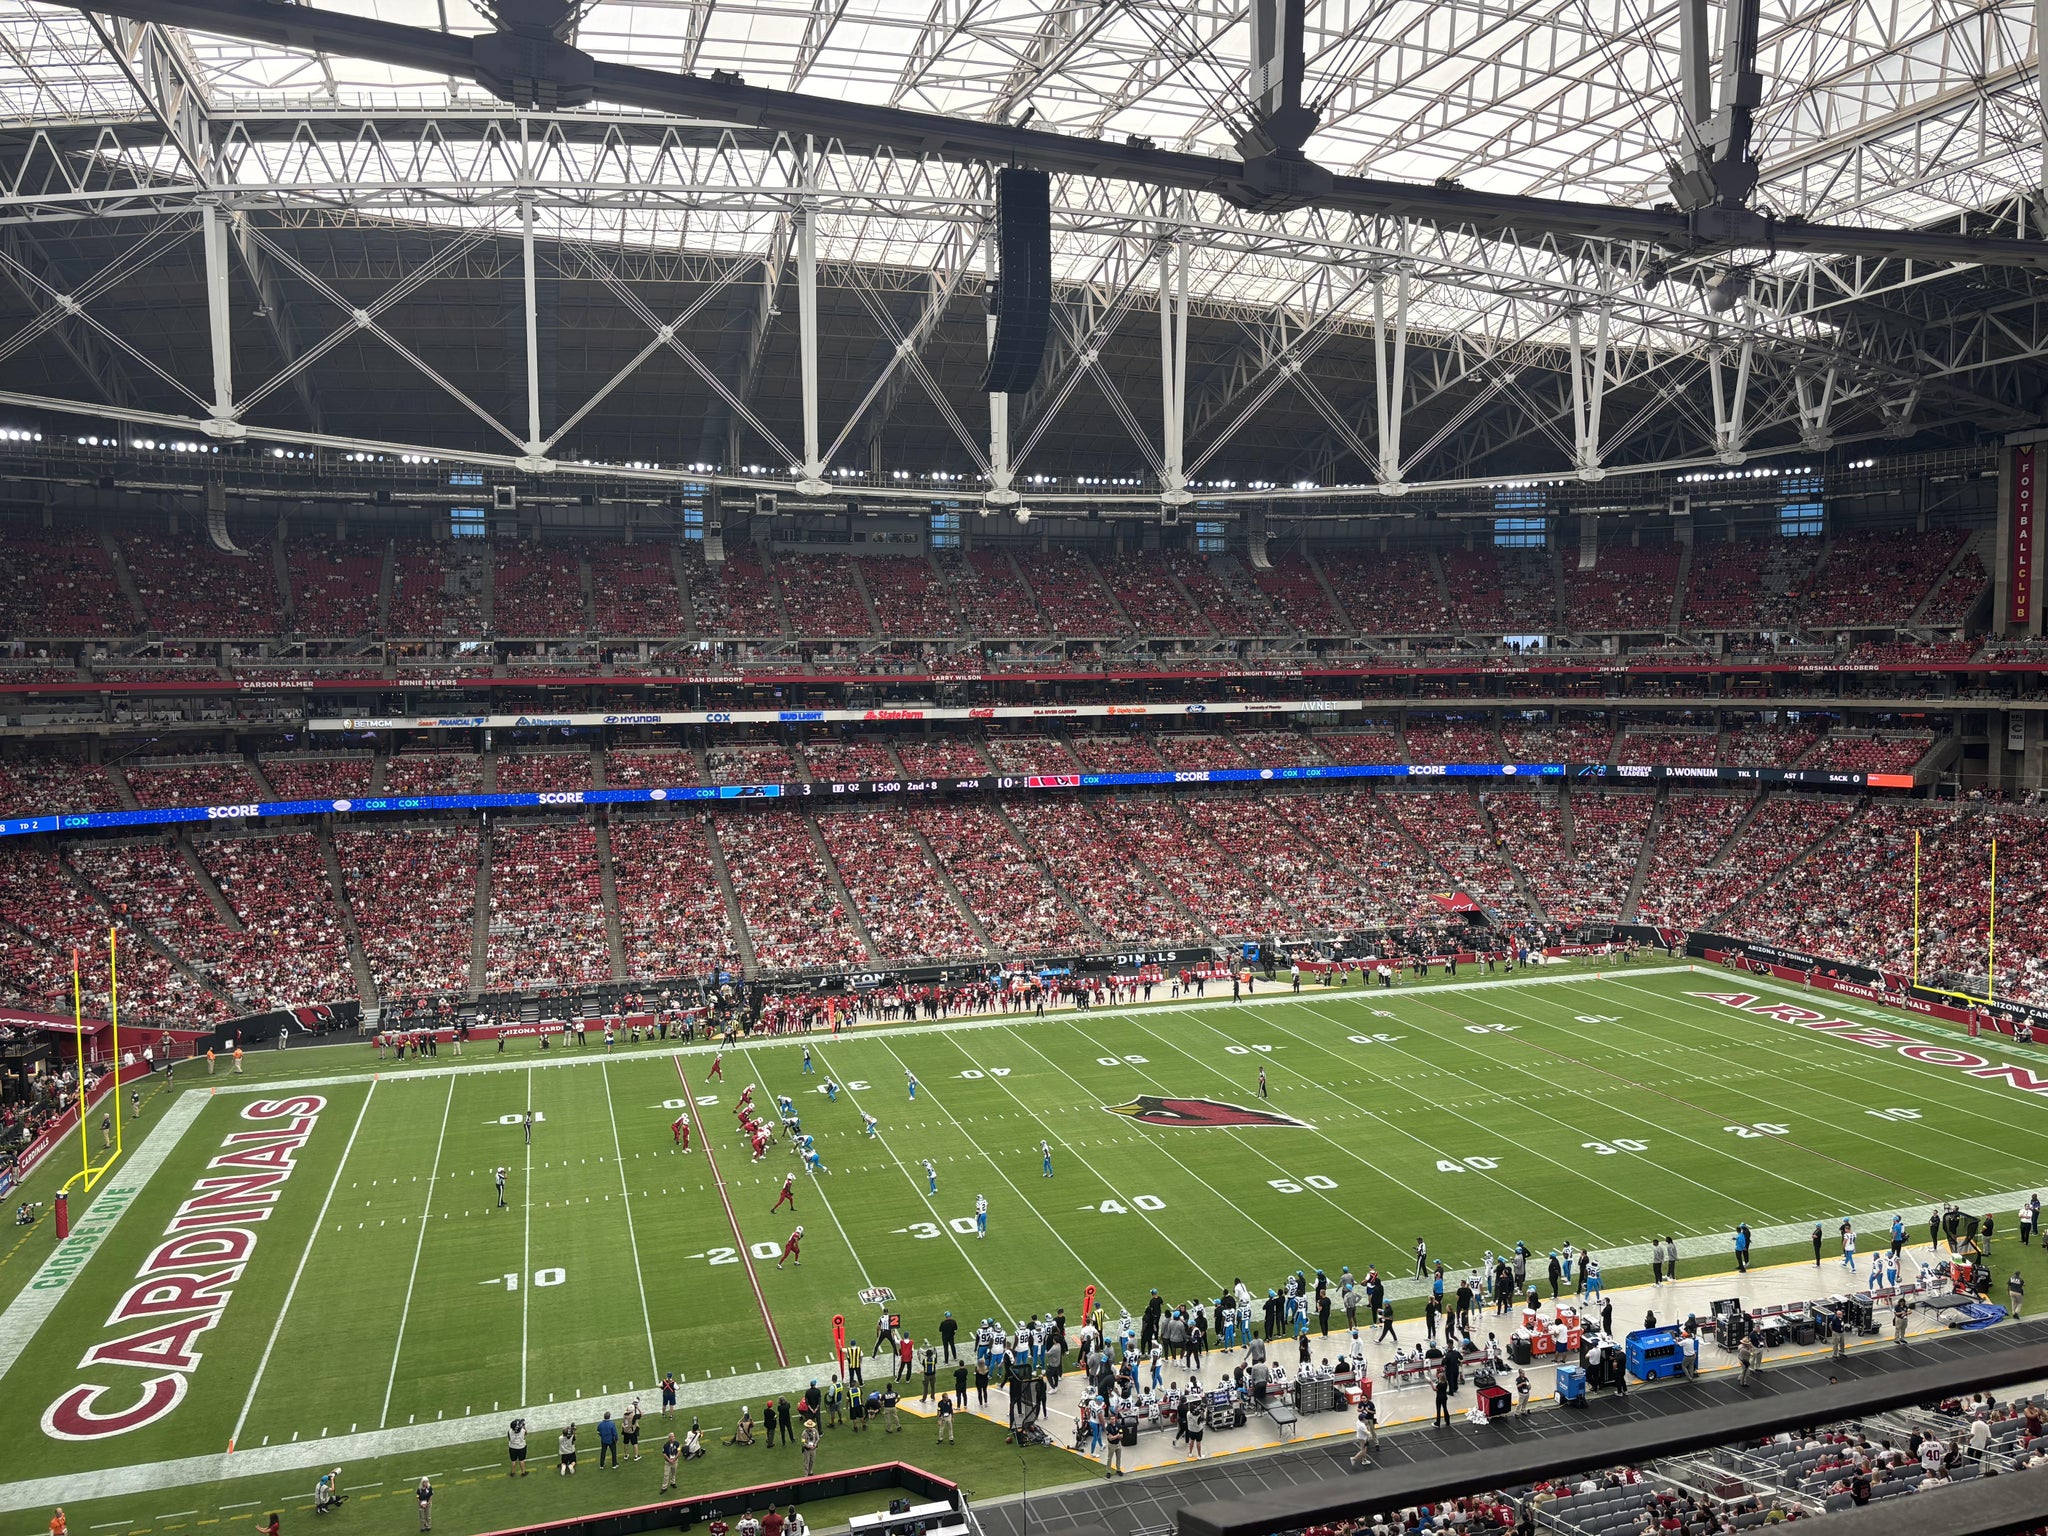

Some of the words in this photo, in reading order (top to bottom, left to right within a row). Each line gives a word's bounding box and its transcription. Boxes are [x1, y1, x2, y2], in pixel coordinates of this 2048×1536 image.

[2019, 463, 2029, 566] FOOTBALL
[2017, 568, 2026, 617] CLUB
[1301, 701, 1337, 710] AVNET
[620, 715, 662, 723] HYUNDAI
[706, 713, 731, 722] COX
[779, 712, 797, 720] BUD
[798, 711, 823, 720] LIGHT
[354, 720, 393, 728] BETMGM
[1282, 769, 1298, 777] COX
[1408, 765, 1446, 775] SCORE
[1666, 767, 1718, 777] D.WONNUM
[1083, 776, 1099, 784] COX
[1175, 771, 1209, 782] SCORE
[1829, 774, 1848, 782] SACK
[1853, 774, 1860, 783] 0
[803, 784, 811, 794] 3
[848, 783, 859, 792] Q2
[872, 783, 901, 792] 15:00
[907, 782, 924, 790] 2nd
[931, 781, 938, 790] 8
[997, 778, 1012, 788] 10
[539, 792, 583, 805] SCORE
[696, 789, 715, 797] COX
[365, 799, 387, 809] COX
[398, 799, 420, 808] COX
[207, 804, 259, 818] SCORE
[32, 821, 38, 829] 2
[64, 817, 89, 827] COX
[1748, 944, 1776, 955] ARIZONA
[1833, 982, 1874, 998] ARIZONA
[1883, 992, 1931, 1012] ARDNALS
[1990, 1000, 2026, 1014] RIZONA
[503, 1027, 536, 1036] RIZONA
[1463, 1023, 1515, 1034] 20
[1346, 1033, 1400, 1045] 30
[1224, 1043, 1273, 1056] 40
[1096, 1054, 1150, 1066] 50
[959, 1067, 1012, 1080] 40
[661, 1095, 719, 1110] 20
[499, 1111, 546, 1125] 10
[1865, 1107, 1923, 1122] 10
[1723, 1122, 1790, 1138] 20
[21, 1137, 50, 1168] CARDINALS
[1581, 1138, 1650, 1155] 30
[1435, 1156, 1499, 1174] 40
[1267, 1174, 1339, 1194] 50
[1099, 1194, 1167, 1214] 40
[909, 1217, 978, 1239] 30
[31, 1225, 107, 1291] CHOOSE
[92, 1186, 137, 1222] LOVE
[706, 1241, 783, 1265] 20
[40, 1094, 328, 1442] CARDINALS
[503, 1267, 567, 1291] 10
[890, 1315, 899, 1326] 2
[1536, 1338, 1548, 1351] G
[1926, 1449, 1940, 1462] 40
